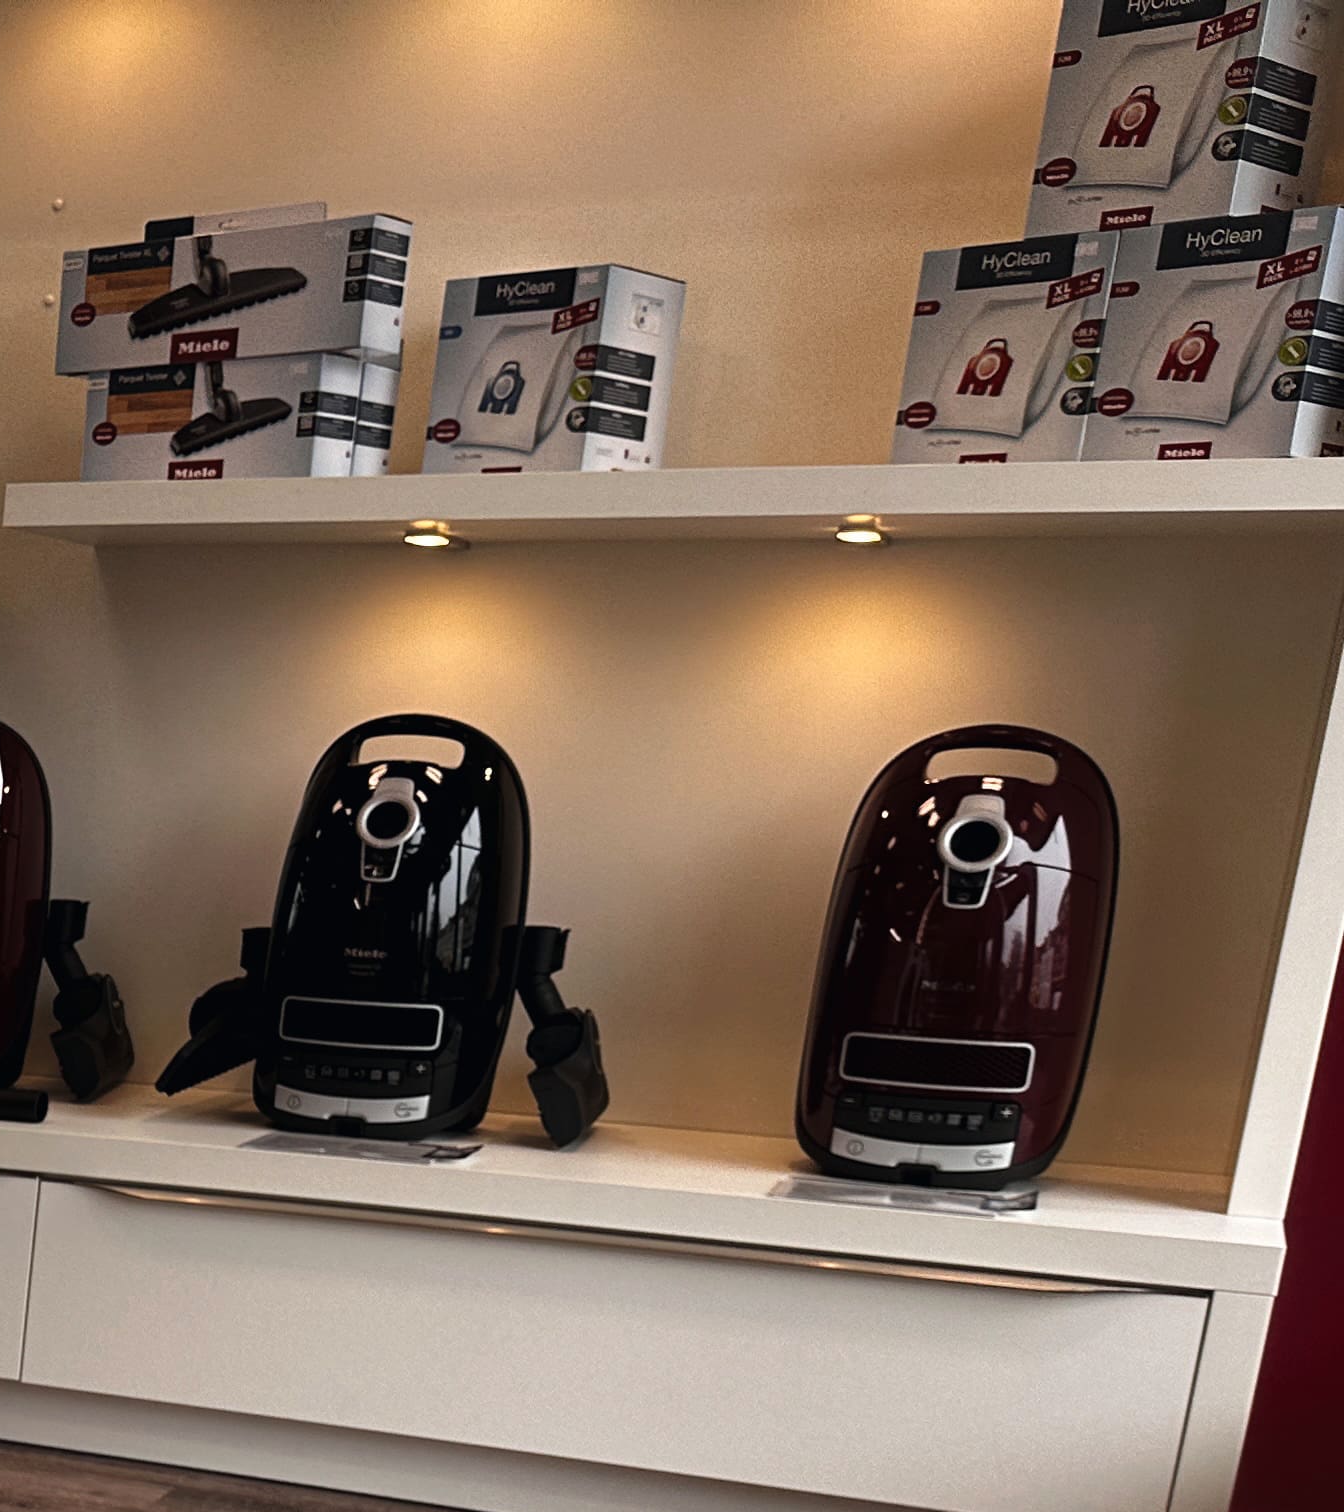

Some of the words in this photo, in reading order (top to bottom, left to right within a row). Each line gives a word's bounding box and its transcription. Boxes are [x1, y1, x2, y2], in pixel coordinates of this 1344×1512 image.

[1106, 213, 1147, 225] Miele
[1185, 228, 1262, 250] HyClean
[981, 251, 1051, 273] HyClean
[1266, 261, 1285, 276] XL
[496, 281, 556, 300] HyClean
[178, 339, 230, 355] Miele
[1164, 447, 1206, 459] Miele
[174, 467, 217, 479] Miele
